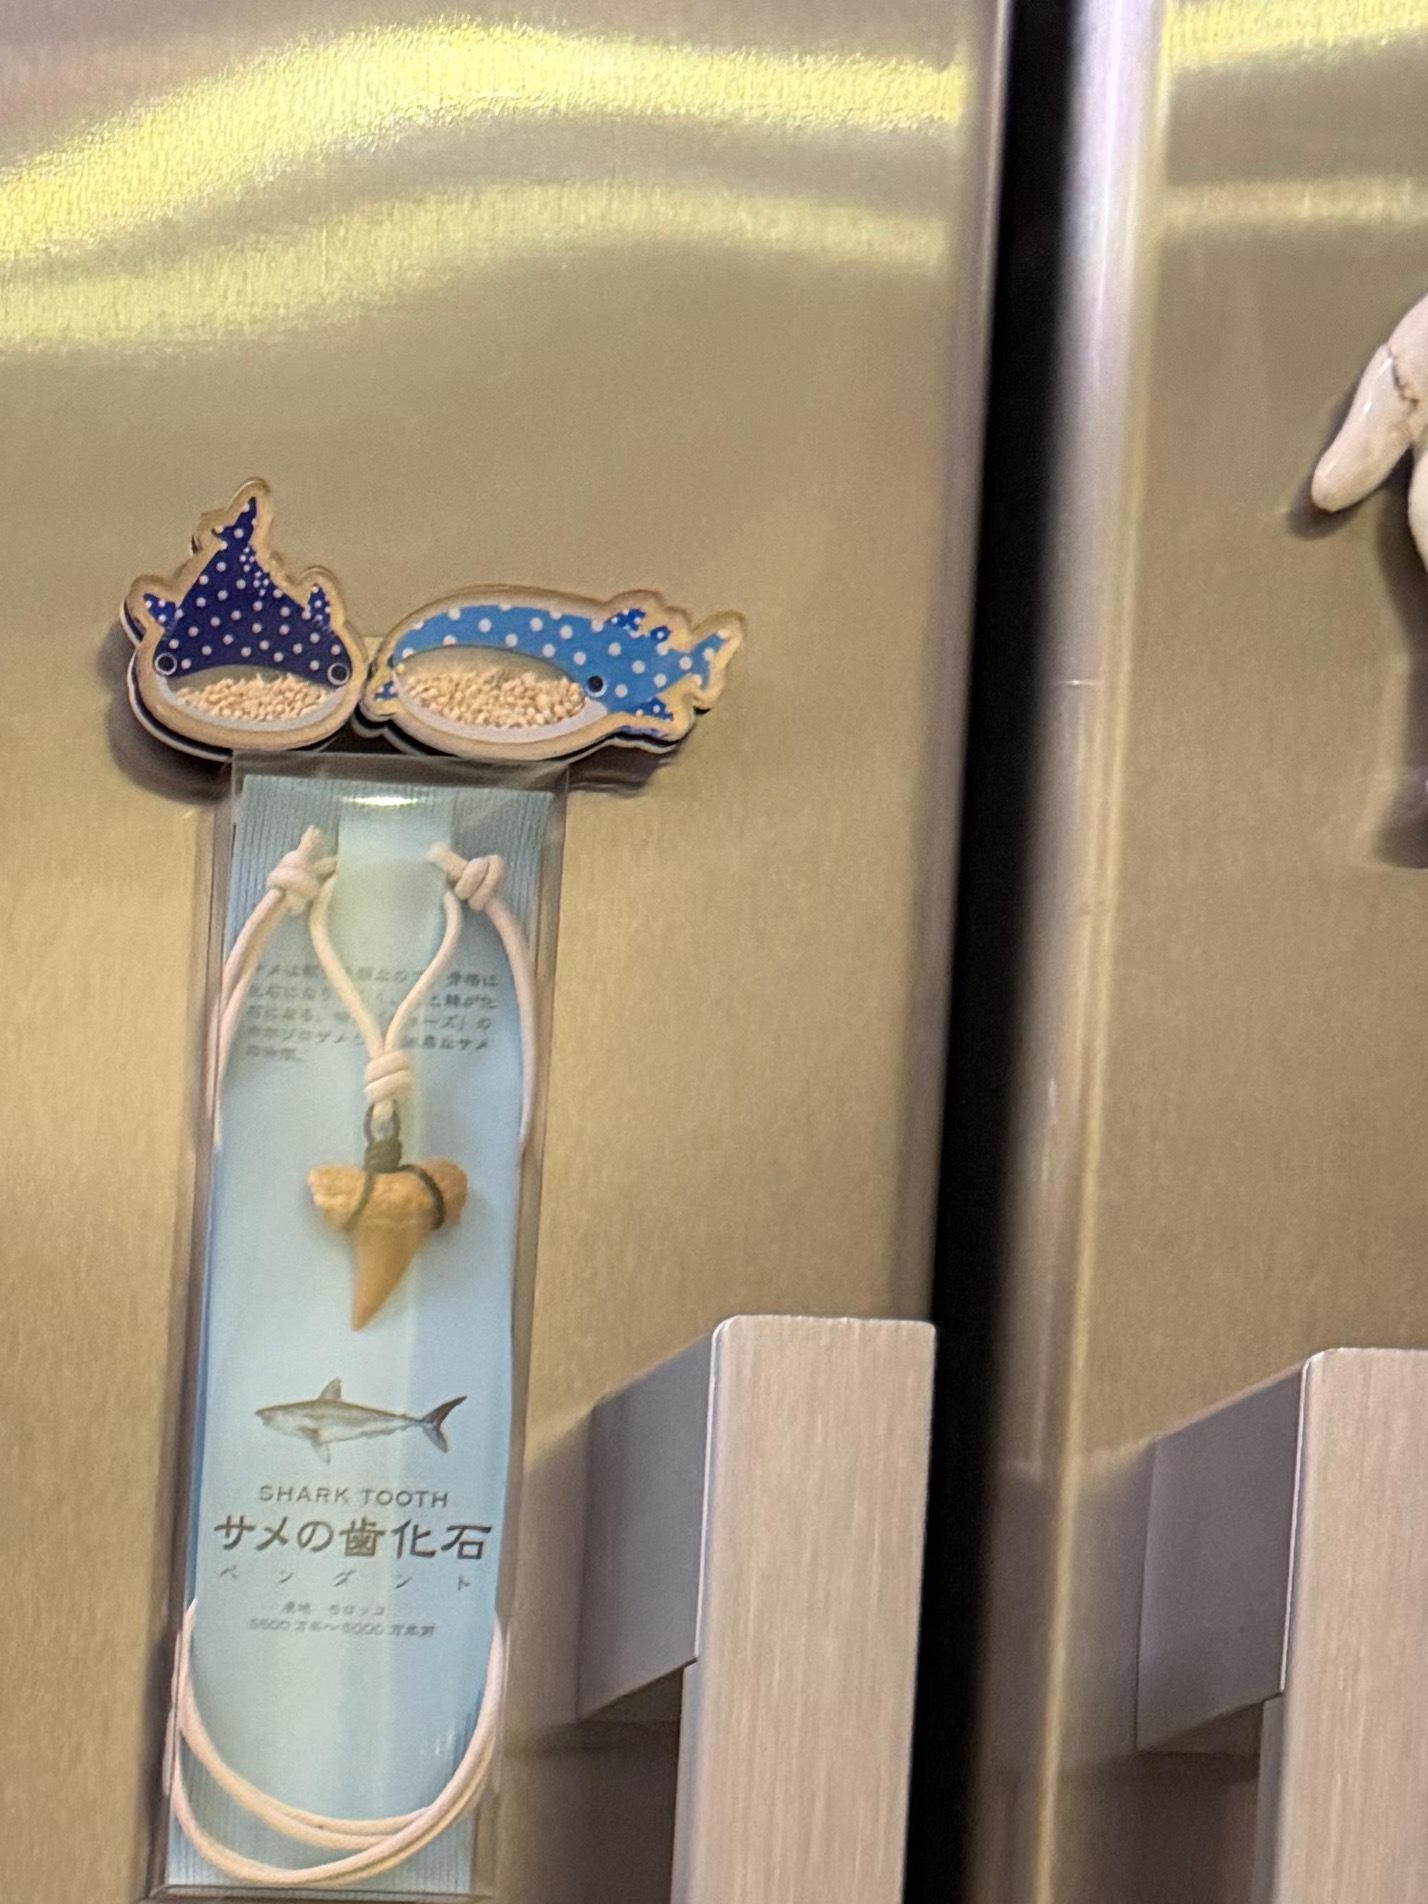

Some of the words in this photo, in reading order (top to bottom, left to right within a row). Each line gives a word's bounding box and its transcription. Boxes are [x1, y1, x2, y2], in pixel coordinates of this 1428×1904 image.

[259, 1484, 348, 1506] SHARK
[361, 1488, 449, 1509] TOOTH
[213, 1514, 493, 1561] サメの歯化石
[219, 1563, 471, 1592] ペンダント
